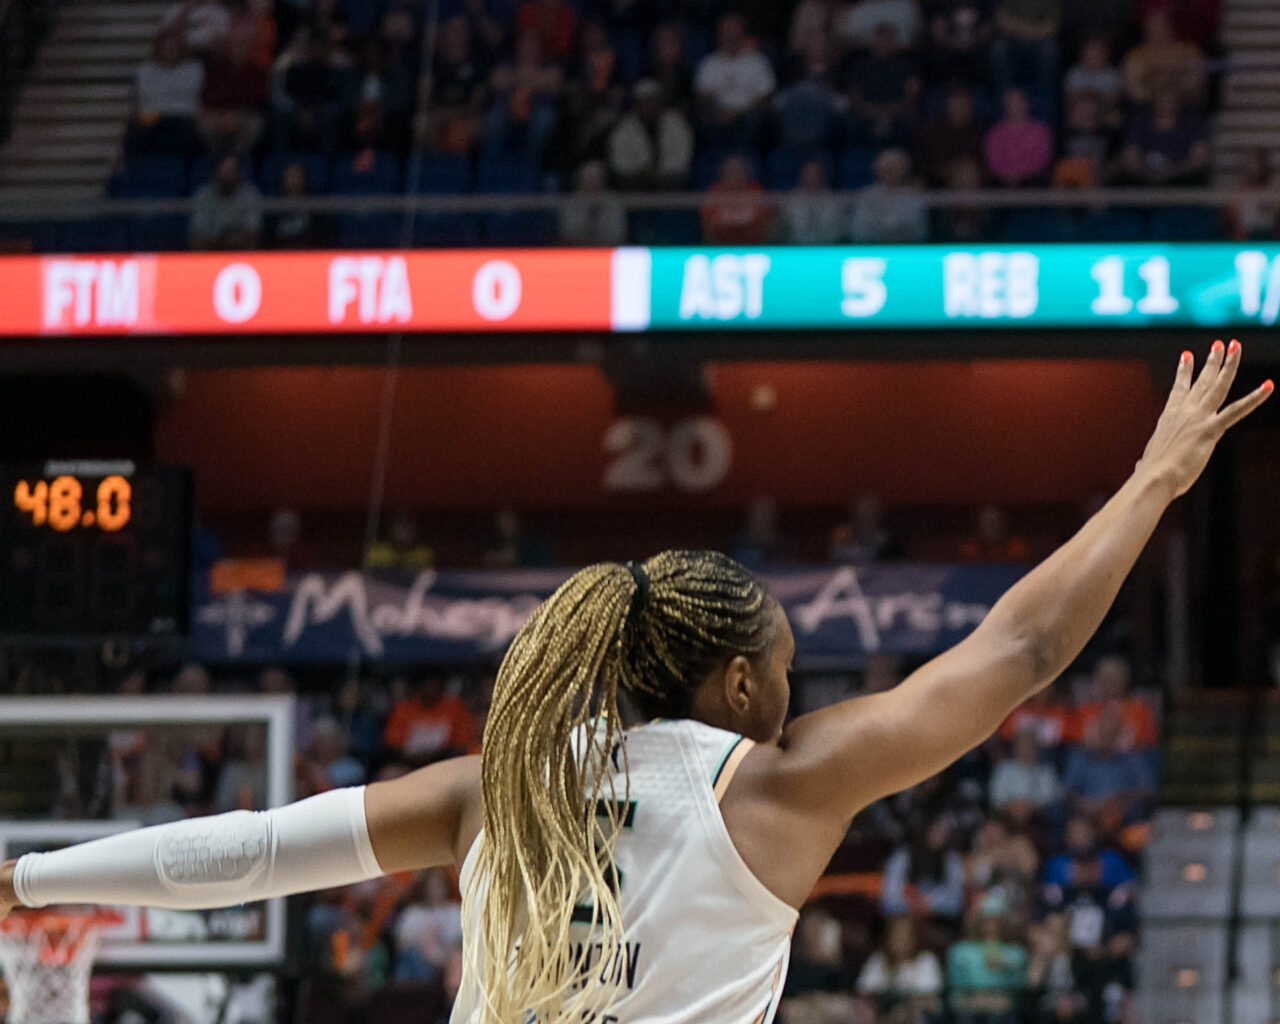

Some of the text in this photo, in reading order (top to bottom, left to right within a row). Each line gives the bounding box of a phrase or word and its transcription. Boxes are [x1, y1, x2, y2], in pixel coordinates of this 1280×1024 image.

[44, 258, 139, 328] FTM
[327, 256, 413, 324] FTA
[679, 253, 770, 319] AST
[840, 256, 887, 318] 5
[942, 252, 1039, 319] REB
[1091, 256, 1179, 317] 11
[603, 416, 732, 491] 20
[14, 474, 132, 531] 48.0
